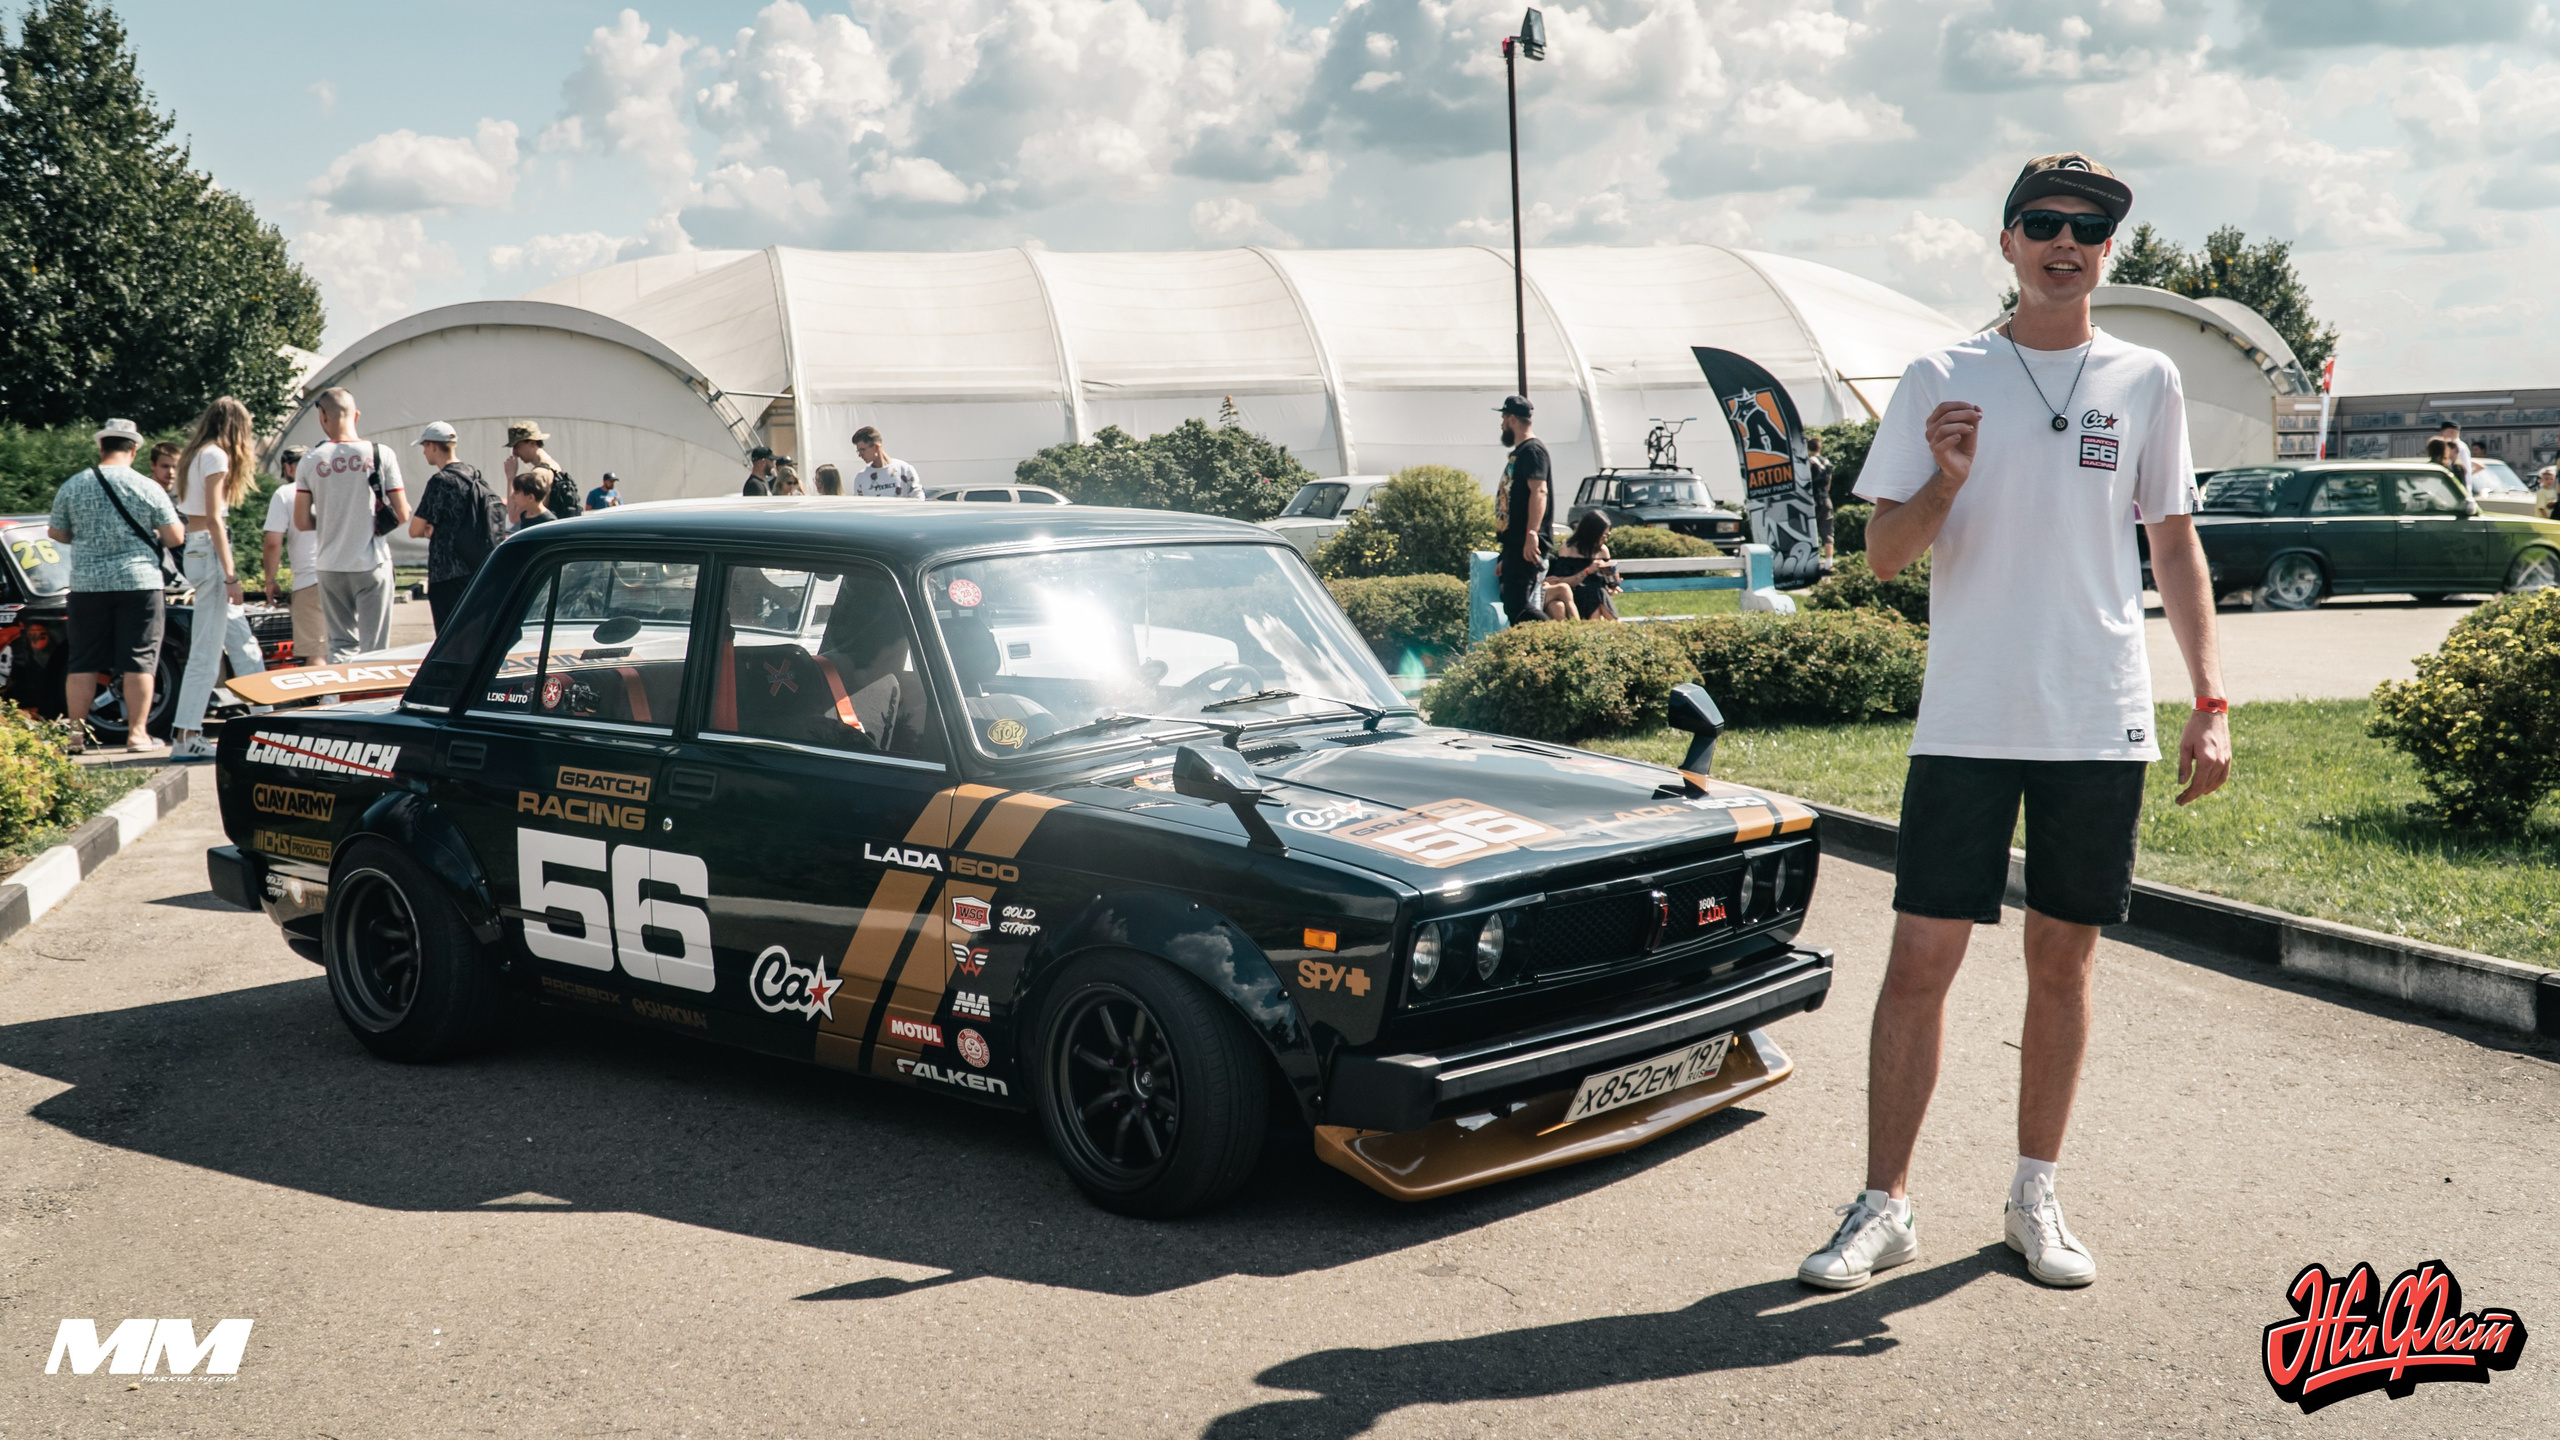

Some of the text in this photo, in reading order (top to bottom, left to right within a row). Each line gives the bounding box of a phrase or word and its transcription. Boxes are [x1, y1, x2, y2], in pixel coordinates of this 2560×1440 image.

[2082, 443, 2117, 463] 56
[2083, 437, 2117, 447] GRATCH
[2082, 460, 2115, 469] RACING
[1749, 466, 1792, 488] ARTON
[1750, 482, 1794, 498] SPRAY PAINT
[12, 538, 61, 570] 26
[996, 724, 1021, 741] TOP
[559, 771, 648, 796] GRATCH
[517, 790, 646, 831] RACING
[1350, 802, 1475, 837] GRATCH
[1584, 804, 1692, 828] LADA
[1371, 810, 1547, 860] 56
[292, 843, 329, 859] PRODUCTS
[864, 842, 1020, 883] LADA 1600
[516, 826, 716, 993] 56
[959, 906, 984, 920] WSG
[1002, 906, 1037, 920] GOLD
[1698, 903, 1727, 926] LADA
[1699, 897, 1715, 910] 1600
[891, 1019, 942, 1043] MOTUL
[896, 1058, 1009, 1096] FALKEN
[1577, 1039, 1726, 1116] Х852ЕМ 197
[1686, 1068, 1706, 1082] RUS
